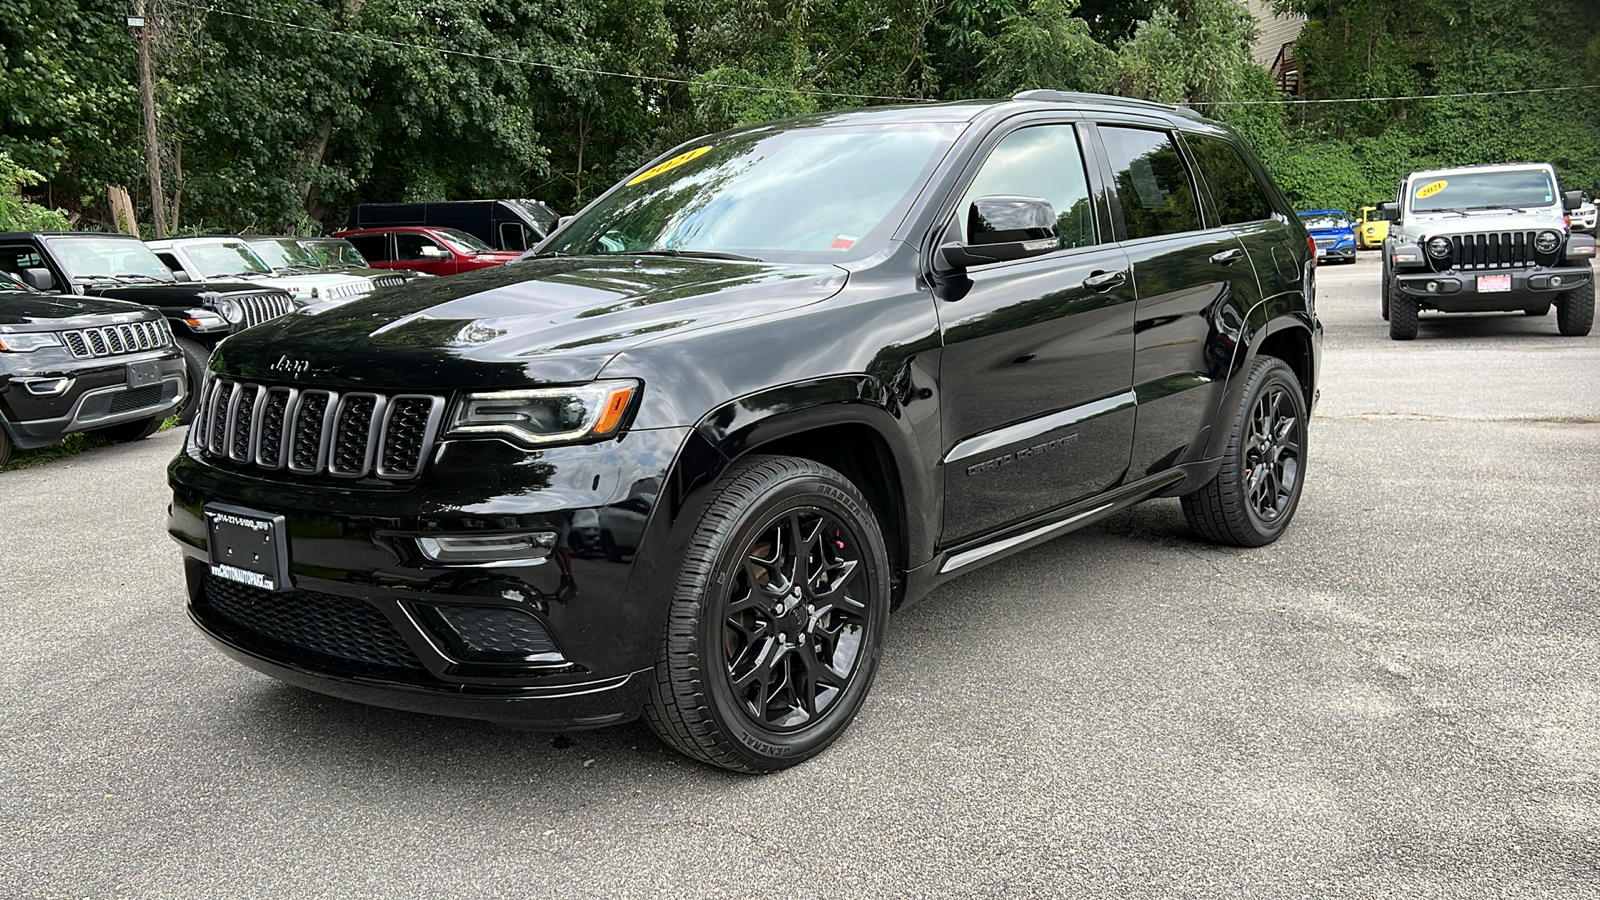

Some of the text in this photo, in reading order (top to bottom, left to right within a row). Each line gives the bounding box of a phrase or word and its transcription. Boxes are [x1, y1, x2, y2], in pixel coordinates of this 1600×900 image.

[1423, 183, 1441, 196] 2021
[270, 354, 310, 380] Jeep
[966, 433, 1078, 476] GRAND CHEROKEE
[817, 485, 861, 517] GRABBER
[742, 731, 790, 756] GENERAL
